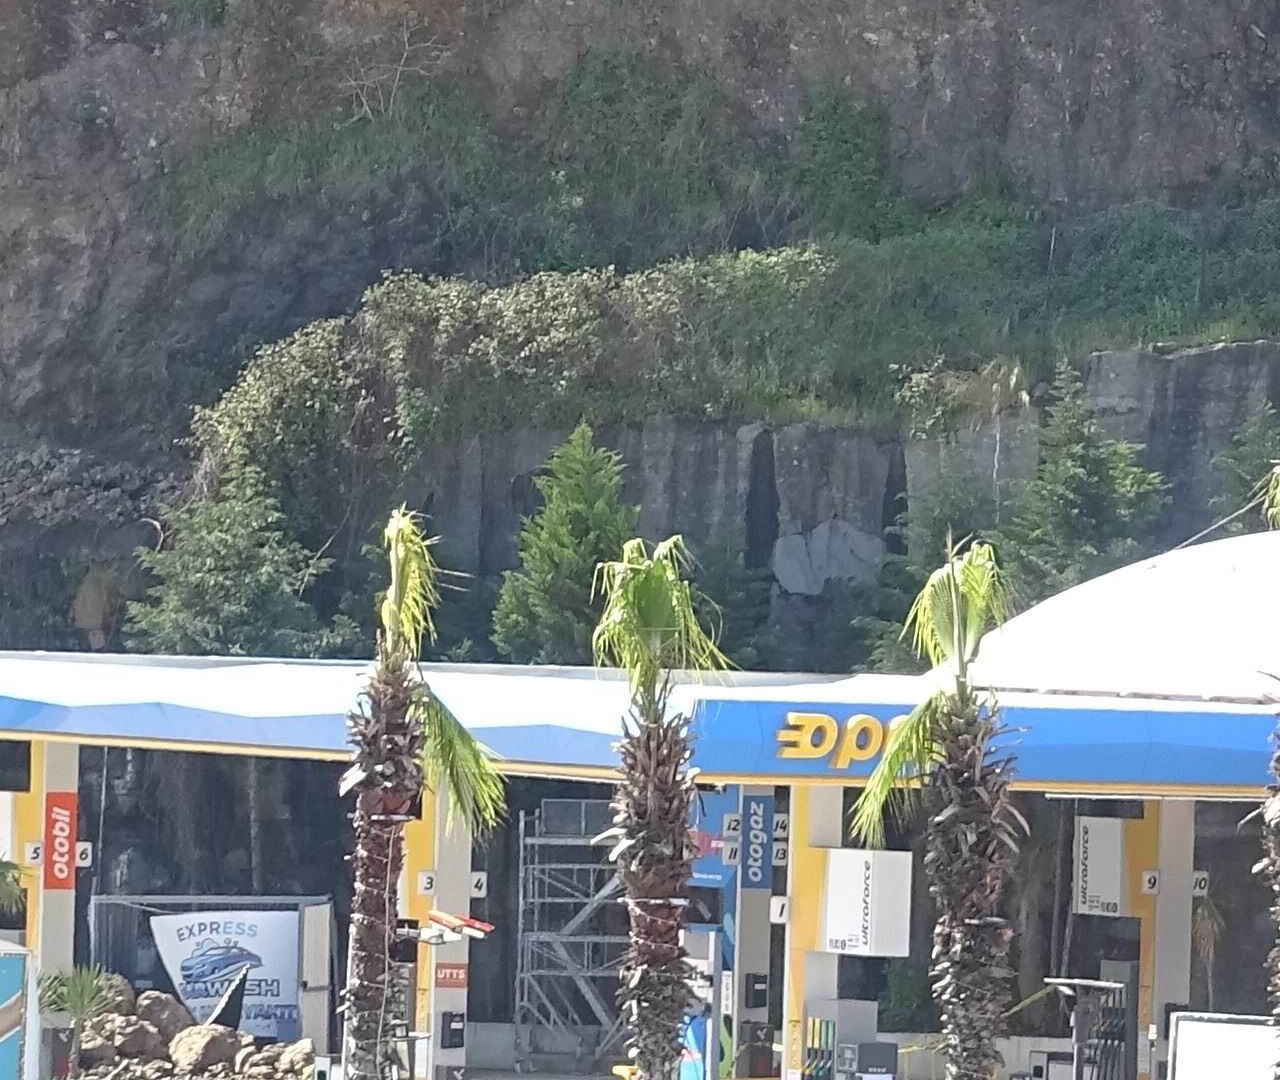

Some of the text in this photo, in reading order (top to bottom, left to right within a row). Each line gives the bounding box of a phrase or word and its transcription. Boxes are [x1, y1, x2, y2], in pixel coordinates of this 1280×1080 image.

[726, 819, 740, 832] 12
[773, 819, 788, 833] 14
[51, 806, 71, 880] otobil
[747, 801, 768, 882] otogaz
[30, 846, 41, 860] 5
[79, 847, 89, 861] 6
[728, 847, 739, 860] 11
[774, 847, 787, 860] 13
[1081, 823, 1090, 905] ultraforce
[423, 875, 434, 890] 3
[473, 877, 484, 892] 4
[1147, 875, 1158, 889] 9
[1194, 877, 1207, 890] 10
[860, 860, 872, 946] ultraforce
[778, 903, 785, 918] 1
[176, 920, 258, 942] EXPRESS
[436, 968, 466, 980] UTTS
